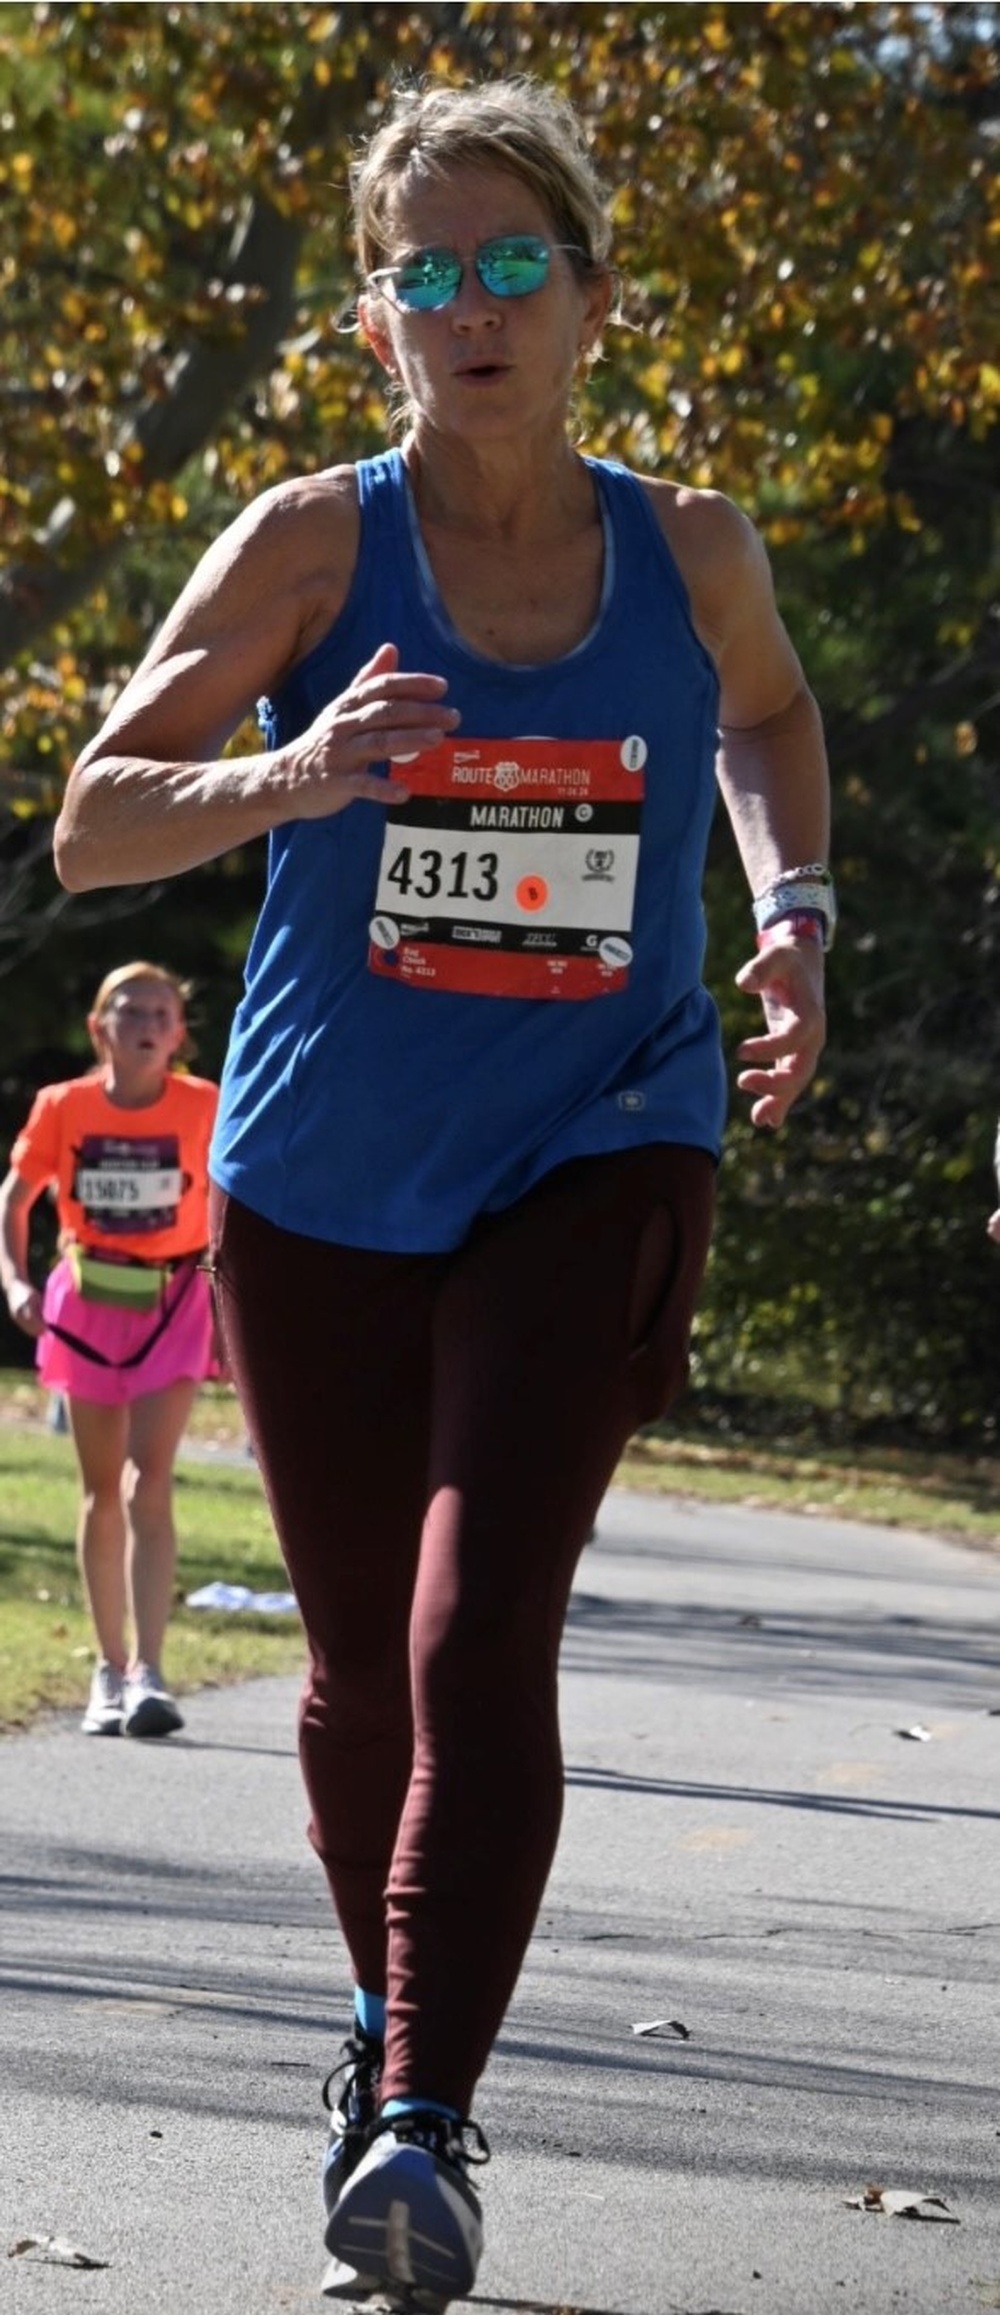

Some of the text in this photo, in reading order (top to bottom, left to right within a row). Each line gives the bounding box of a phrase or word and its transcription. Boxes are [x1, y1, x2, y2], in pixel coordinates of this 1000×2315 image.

[452, 767, 493, 784] ROUTE
[520, 767, 591, 785] MARATHON
[470, 805, 564, 828] MARATHON
[387, 846, 499, 902] 4313
[86, 1178, 139, 1201] 15075
